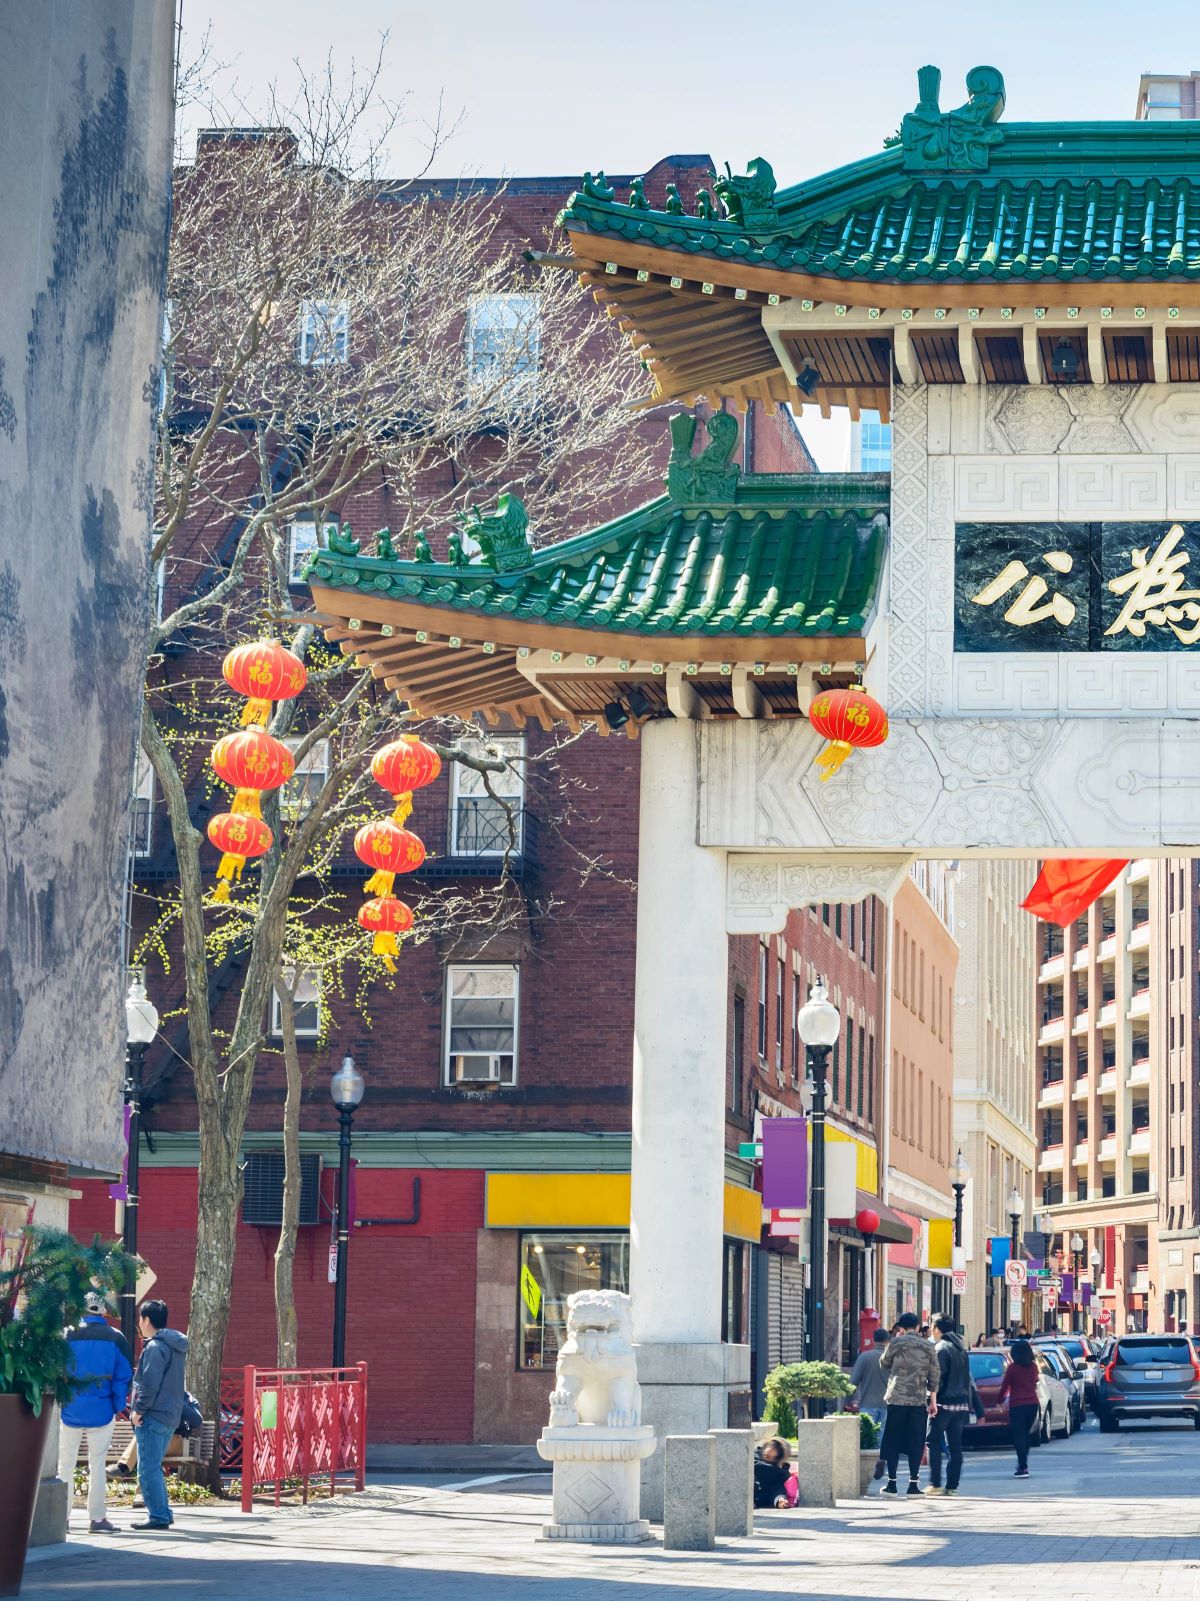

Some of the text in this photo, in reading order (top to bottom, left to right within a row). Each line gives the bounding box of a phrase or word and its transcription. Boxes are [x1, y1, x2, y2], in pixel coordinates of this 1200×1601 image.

[248, 659, 274, 685] 福
[847, 702, 870, 727] 福
[246, 749, 270, 774] 福
[399, 756, 420, 777] 福
[227, 823, 248, 842] 福
[372, 833, 393, 855] 福
